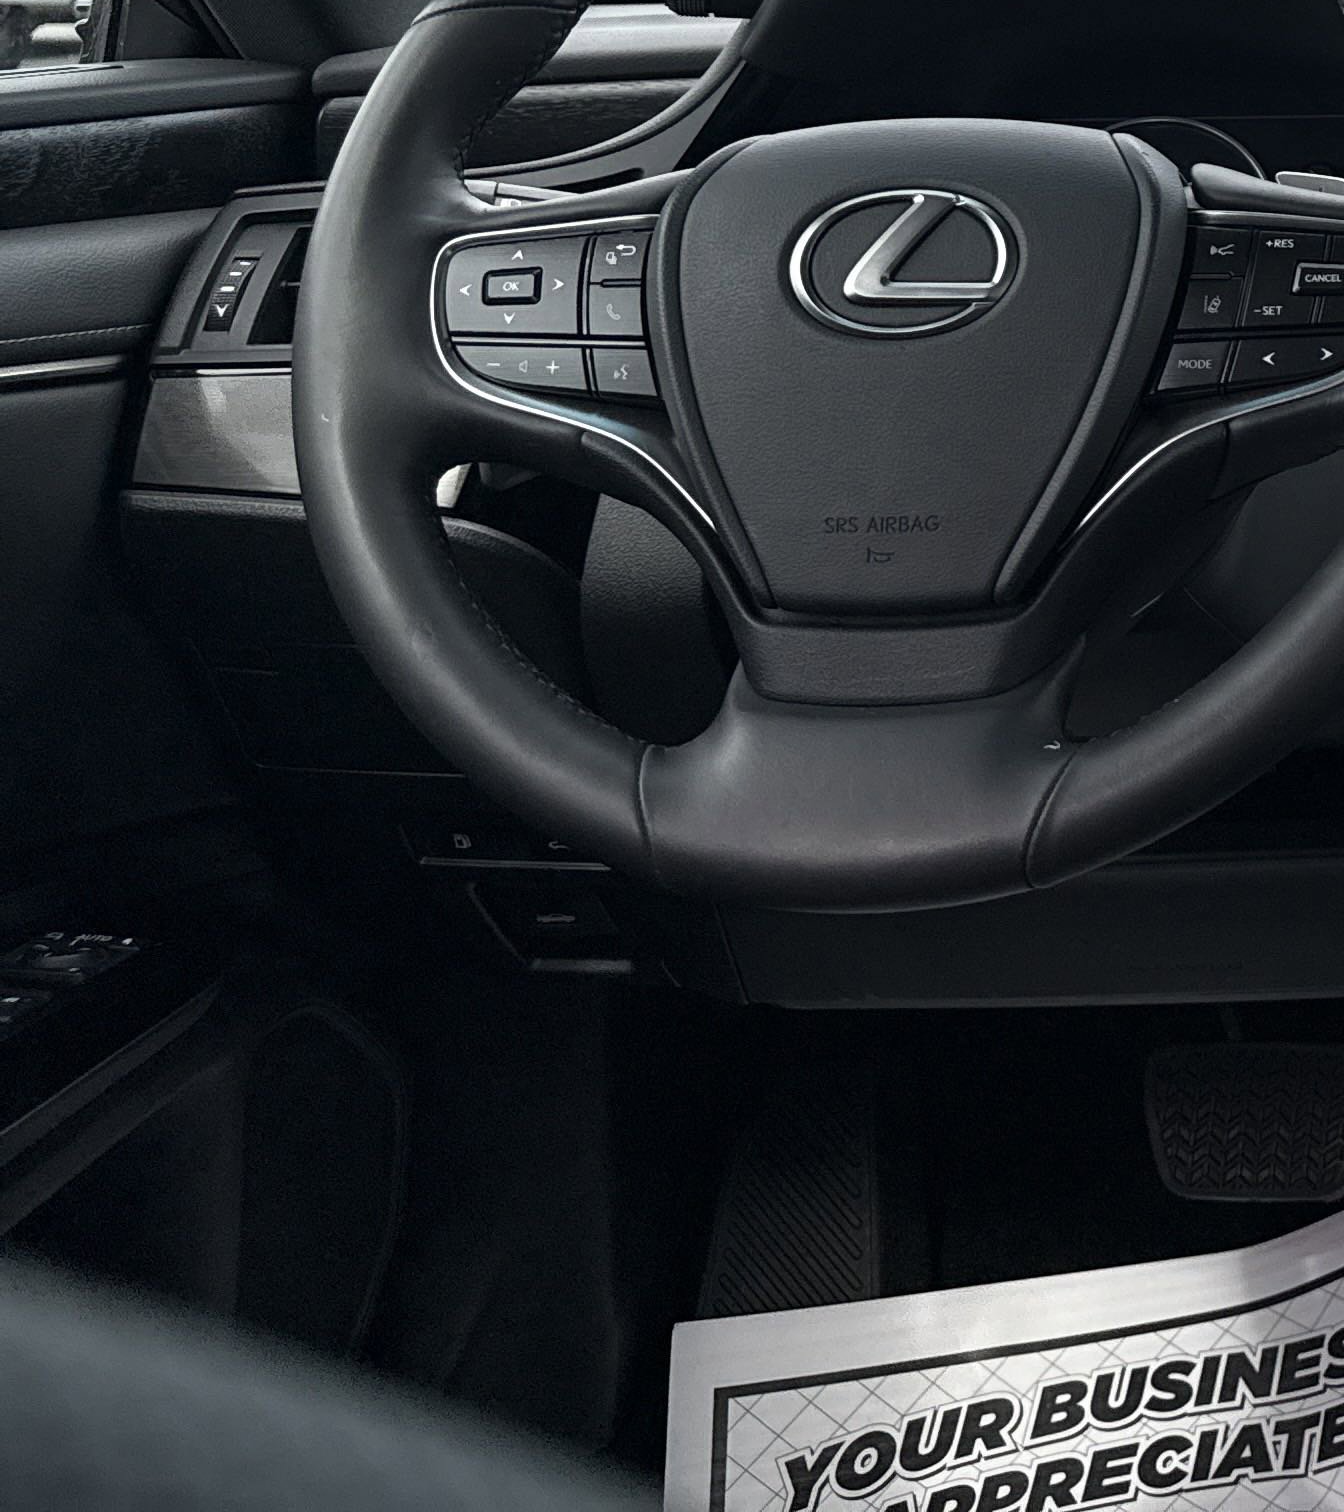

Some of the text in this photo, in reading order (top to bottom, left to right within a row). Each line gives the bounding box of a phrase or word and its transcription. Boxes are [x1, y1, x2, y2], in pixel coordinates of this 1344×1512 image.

[1304, 272, 1343, 284] CANCEL
[501, 280, 521, 293] OK
[1177, 359, 1213, 370] MODE
[823, 515, 941, 535] SRS AIRBAG
[782, 1395, 1020, 1512] YOUR
